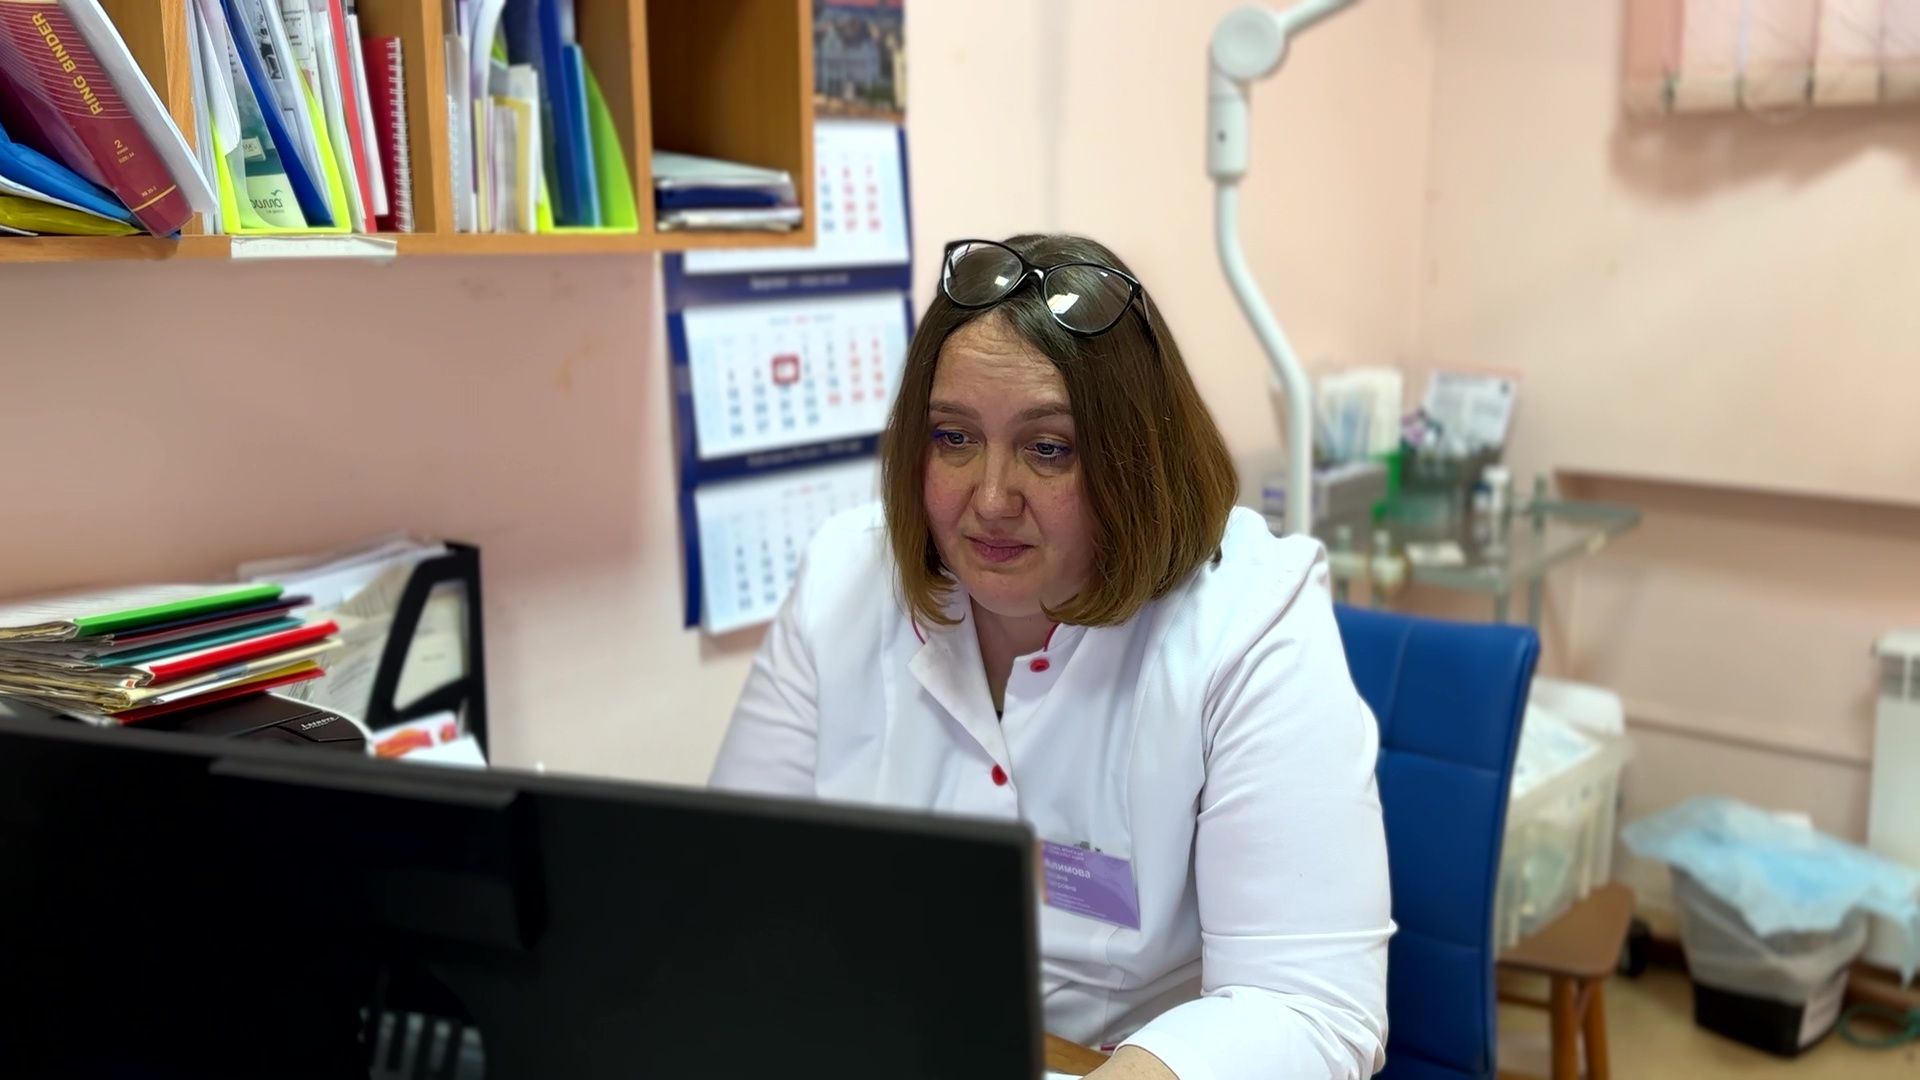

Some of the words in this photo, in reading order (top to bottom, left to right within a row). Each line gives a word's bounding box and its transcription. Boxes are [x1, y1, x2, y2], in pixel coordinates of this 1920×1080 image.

[32, 12, 77, 73] BINDER
[73, 75, 103, 114] RING
[114, 139, 123, 149] 2
